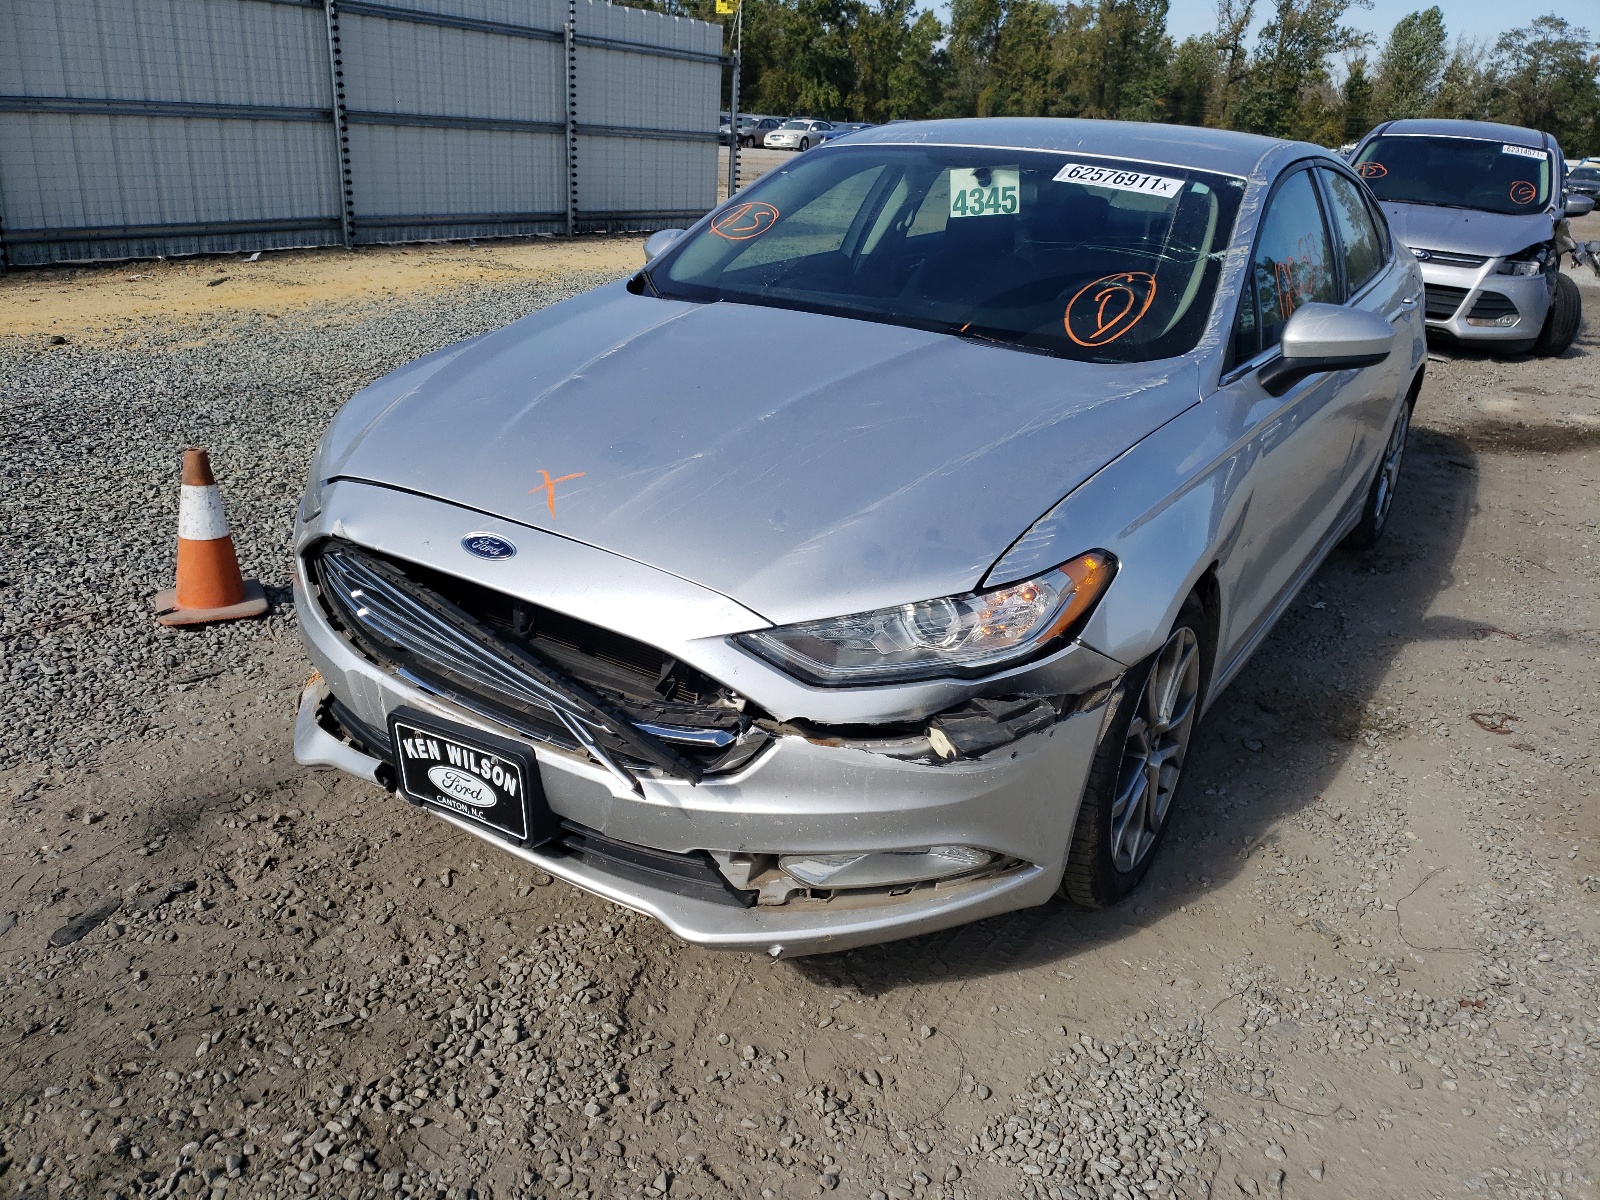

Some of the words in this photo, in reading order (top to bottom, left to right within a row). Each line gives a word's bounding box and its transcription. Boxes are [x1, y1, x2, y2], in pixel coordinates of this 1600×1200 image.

[953, 186, 1017, 216] 4345
[471, 537, 505, 555] Ford
[402, 738, 441, 761] KEN
[445, 743, 517, 797] WILSON
[441, 771, 484, 801] Ford
[436, 795, 470, 815] CANTON,
[470, 807, 487, 820] N.C.
